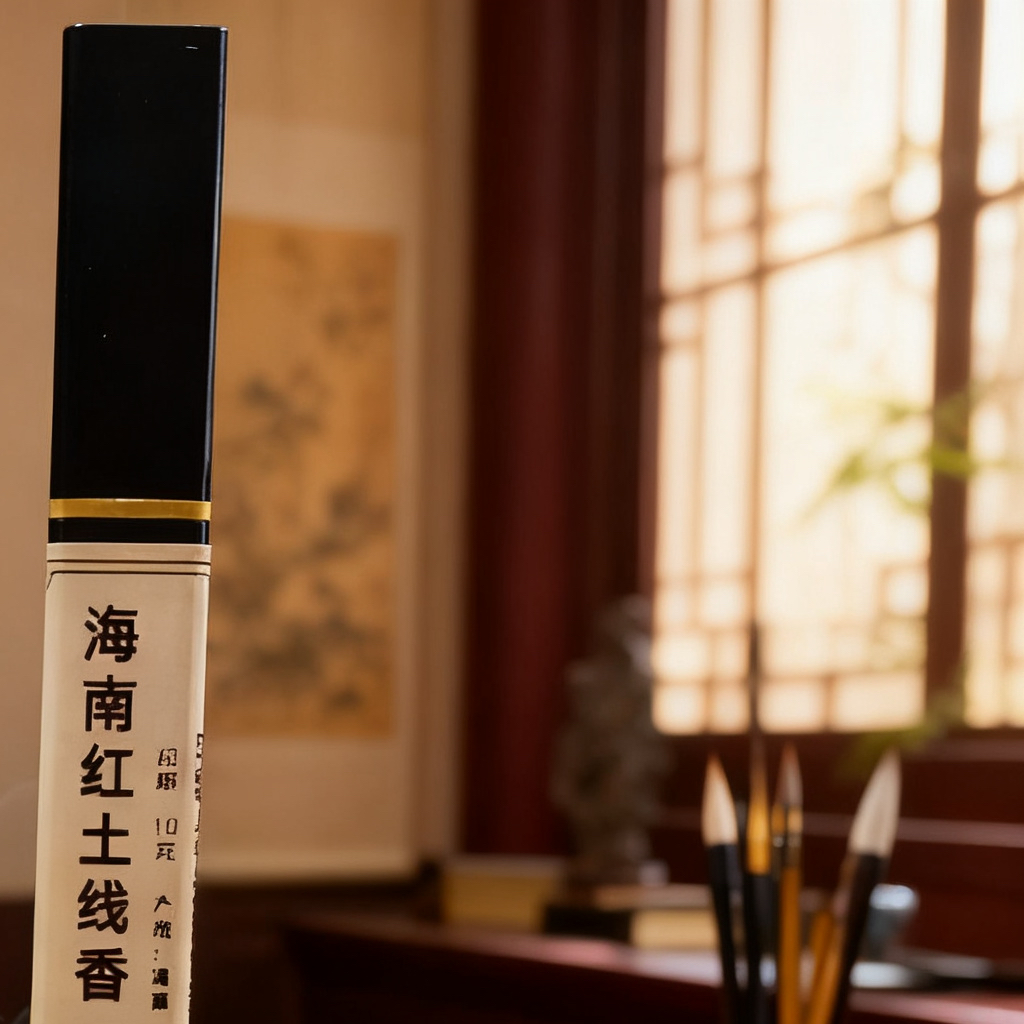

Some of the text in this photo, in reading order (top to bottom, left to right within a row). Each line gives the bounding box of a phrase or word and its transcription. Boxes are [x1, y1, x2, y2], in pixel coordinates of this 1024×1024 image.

[75, 604, 140, 1003] 海南红土线香
